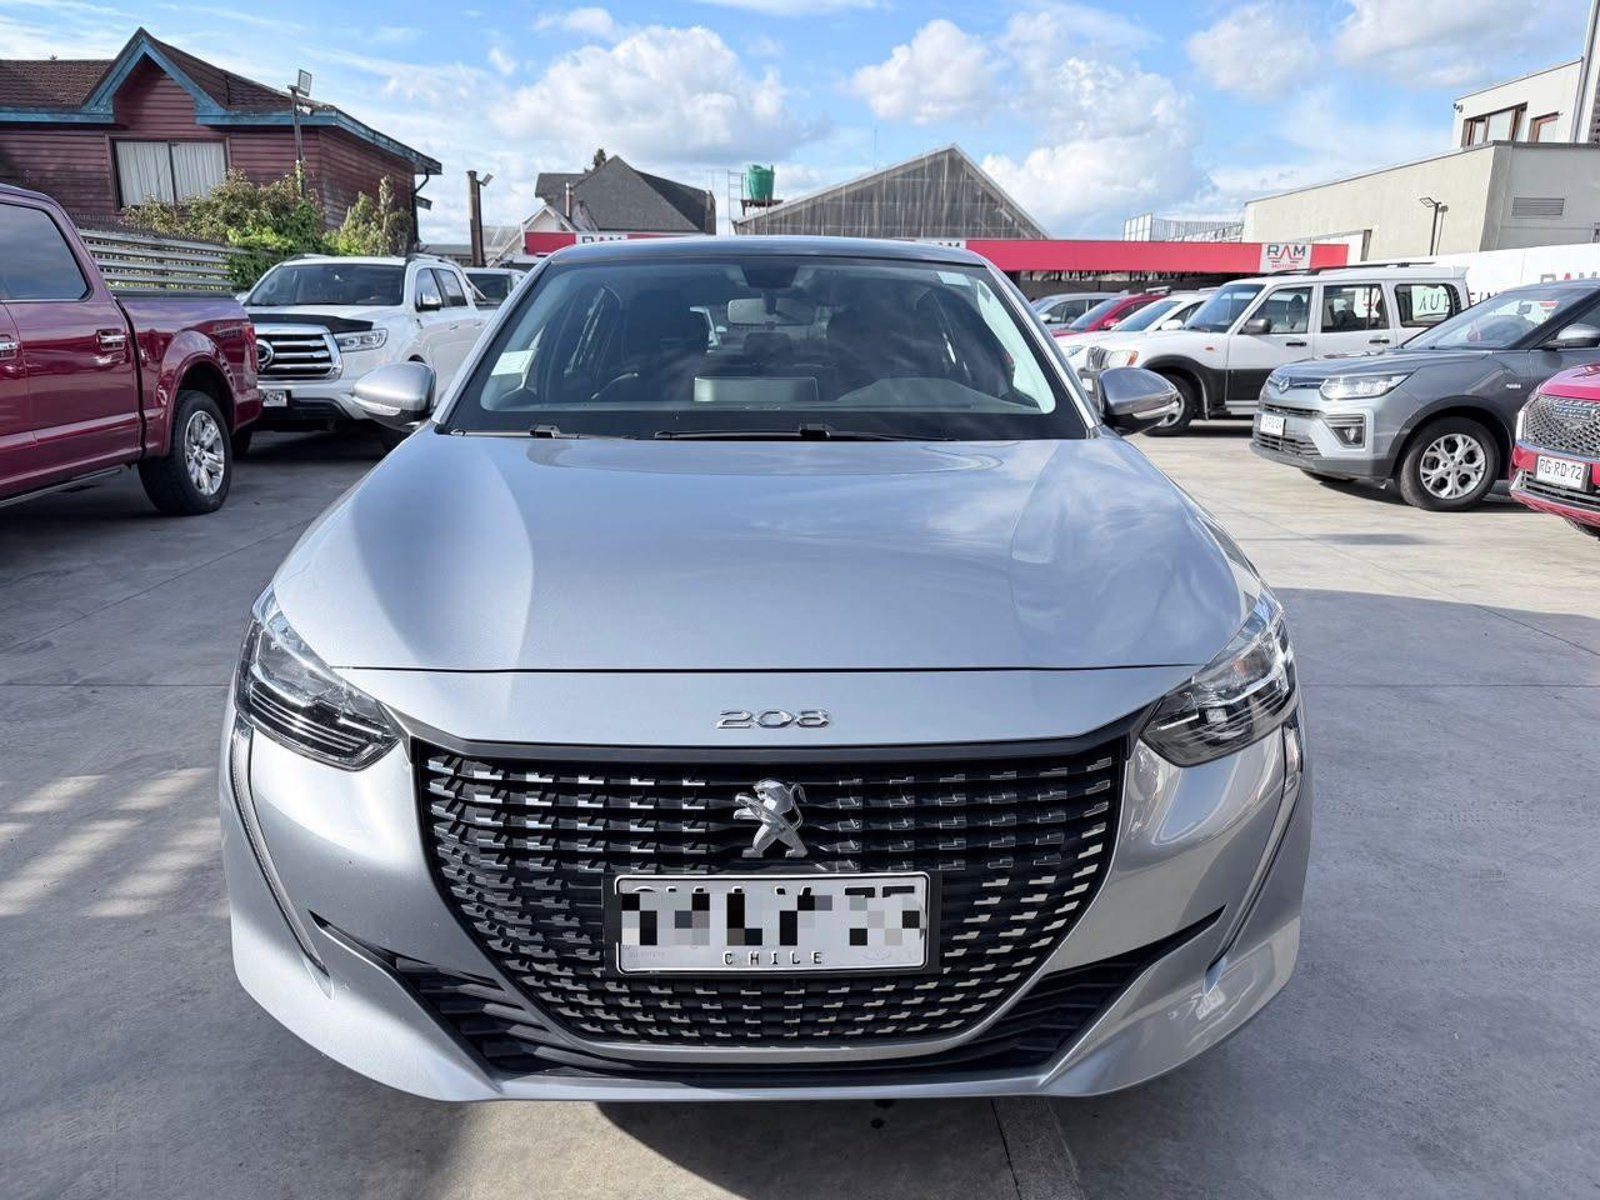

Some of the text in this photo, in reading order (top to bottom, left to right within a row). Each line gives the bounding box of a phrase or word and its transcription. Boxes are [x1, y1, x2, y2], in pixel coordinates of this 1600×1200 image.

[1267, 244, 1306, 260] RAM
[717, 709, 829, 729] 208
[723, 951, 824, 965] CHILE
